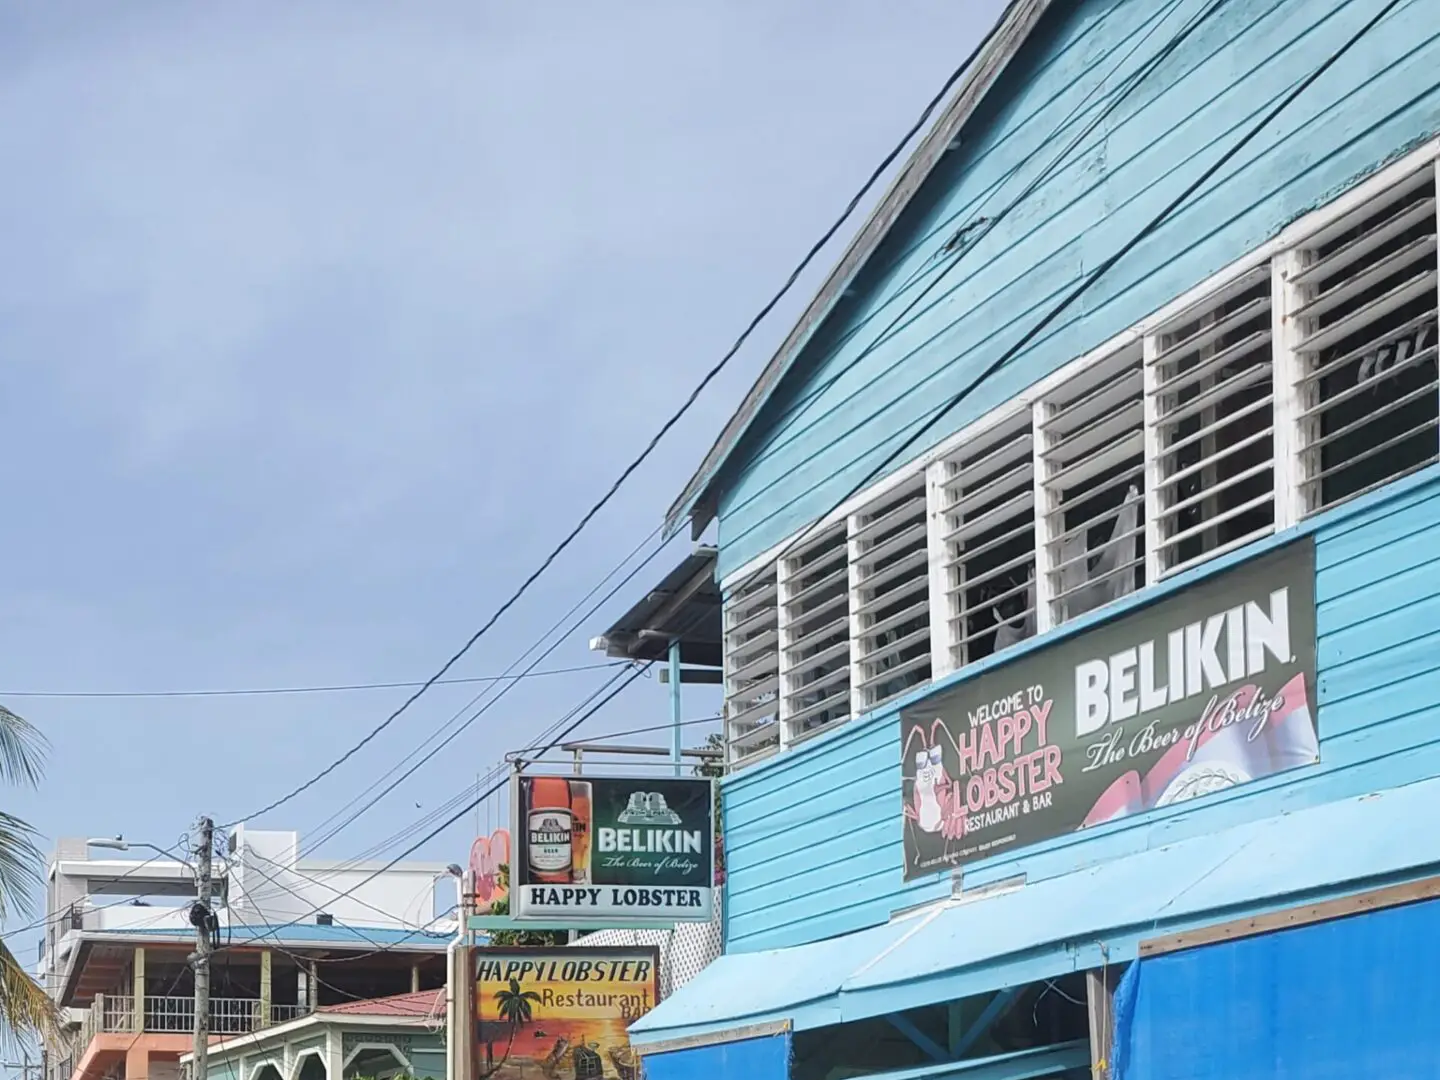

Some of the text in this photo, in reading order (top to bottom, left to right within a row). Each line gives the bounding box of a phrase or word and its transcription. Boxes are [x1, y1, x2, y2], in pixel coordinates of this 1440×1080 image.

[1075, 586, 1291, 737] BELIKIN
[968, 684, 1043, 728] WELCOME TO
[959, 699, 1053, 775] HAPPY
[1082, 687, 1285, 772] The Beer of Belize
[952, 745, 1063, 817] LOBSTER
[964, 792, 1052, 834] RESTAURANT & BAR
[531, 832, 569, 842] BELIKIN
[598, 827, 702, 854] BELIKIN
[602, 856, 698, 874] The Beer of Belize
[531, 888, 702, 907] HAPPY LOBSTER
[542, 988, 649, 1007] Restaurant
